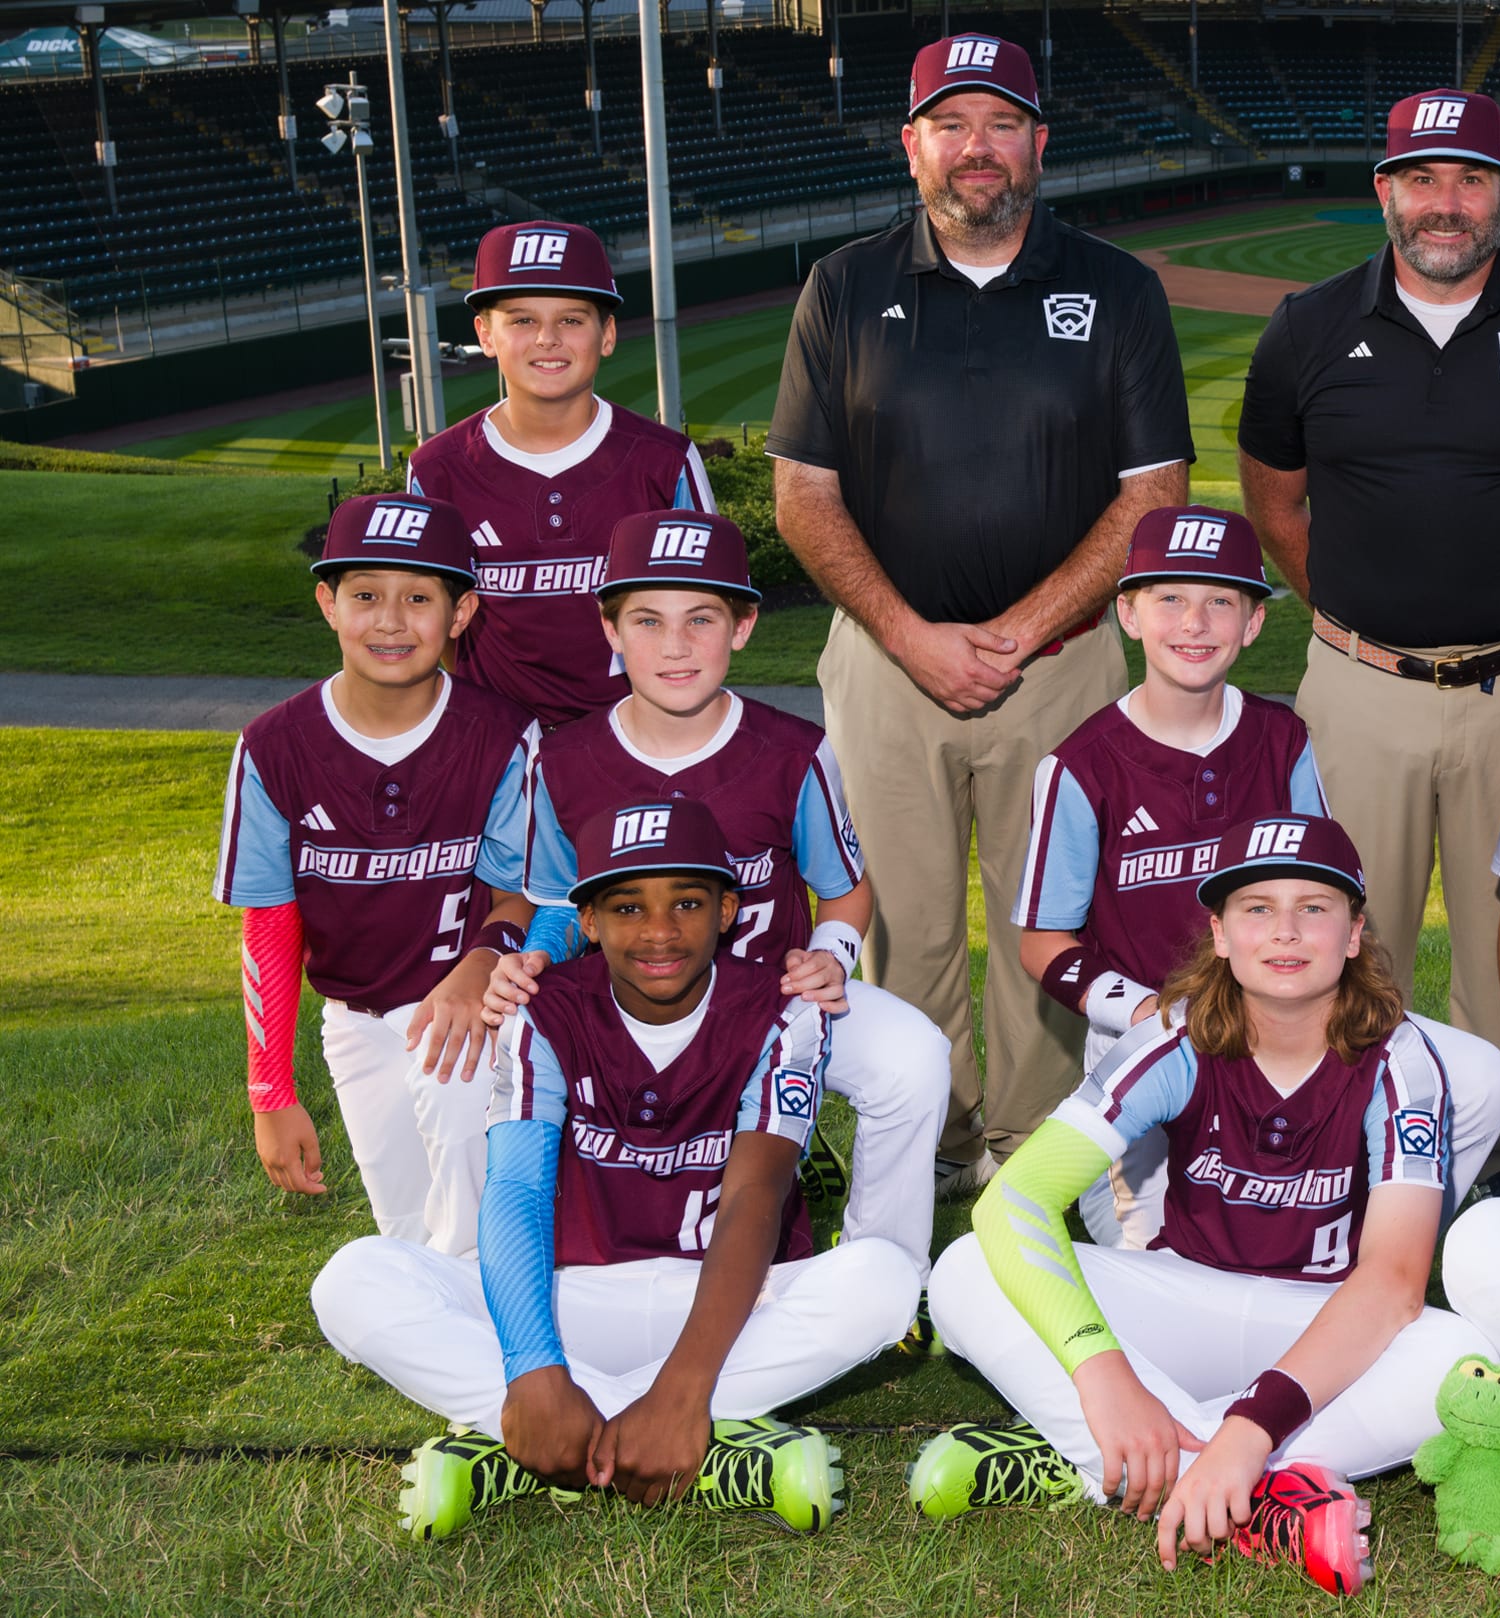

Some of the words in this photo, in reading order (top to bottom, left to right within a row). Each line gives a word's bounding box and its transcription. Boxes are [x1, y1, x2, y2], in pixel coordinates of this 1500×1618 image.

[26, 39, 76, 53] DICK
[946, 40, 999, 69] ne
[1411, 101, 1467, 131] ne
[509, 233, 567, 266] ne
[364, 507, 430, 541] ne
[1167, 520, 1228, 552] ne
[650, 526, 712, 560] ne
[533, 555, 609, 594] engl
[611, 809, 672, 849] ne
[1244, 823, 1307, 858] ne
[297, 846, 359, 878] new
[1117, 850, 1184, 886] new
[430, 886, 472, 962] 5
[1239, 1165, 1353, 1208] englnd
[1301, 1210, 1353, 1275] 9
